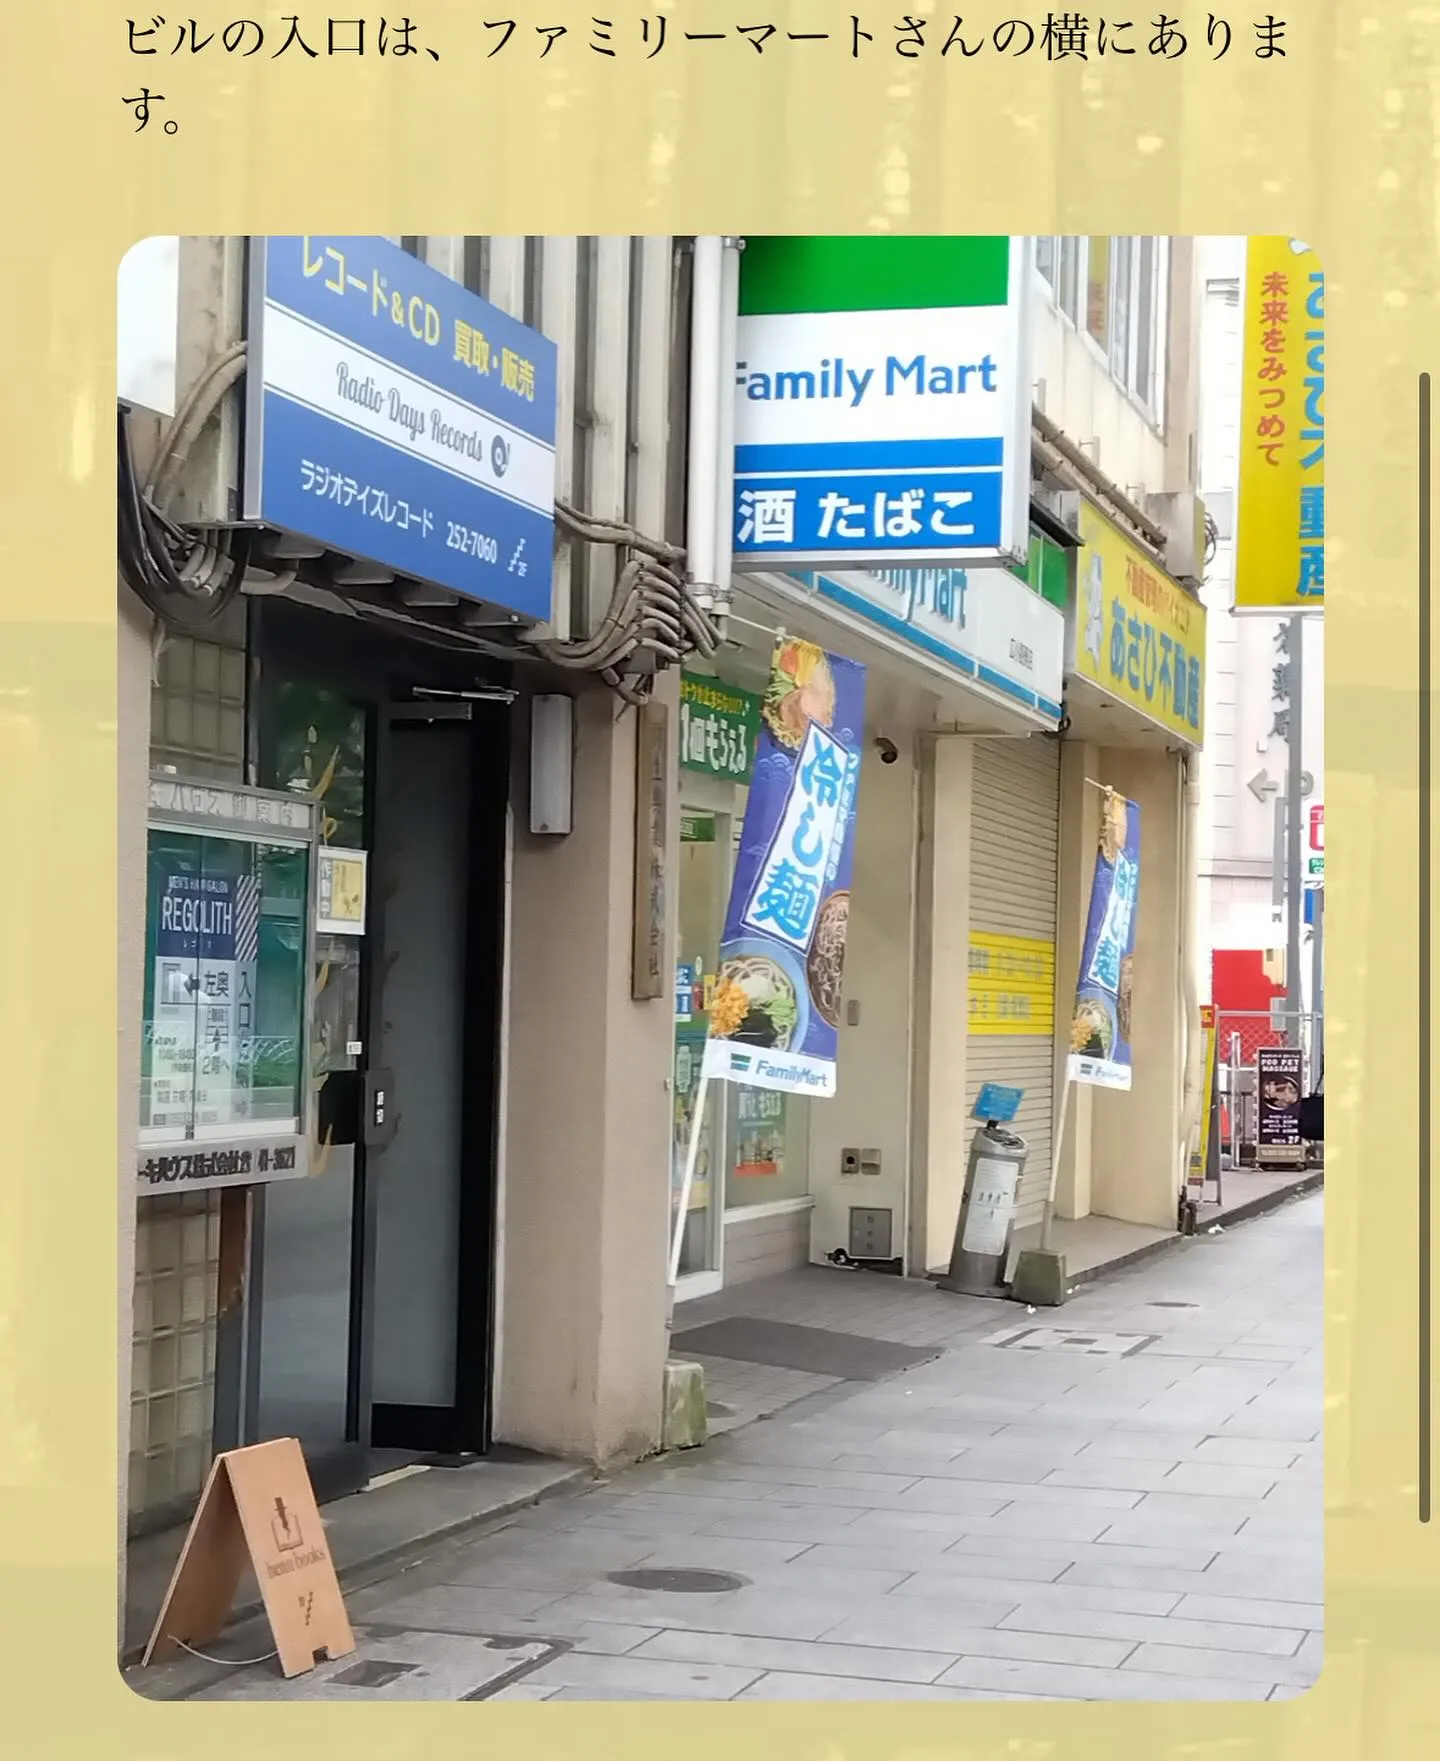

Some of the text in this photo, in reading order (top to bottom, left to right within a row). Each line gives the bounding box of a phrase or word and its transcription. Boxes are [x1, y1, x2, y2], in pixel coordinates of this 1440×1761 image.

[303, 236, 535, 401] レコード&CD 買取・販売
[1257, 272, 1289, 467] 未来をみつめて
[336, 361, 483, 464] Radio Days Records
[301, 458, 435, 539] ラジオデイズレコード
[446, 521, 498, 565] 252-7060
[737, 489, 974, 544] 酒 たばこ
[1111, 596, 1199, 730] あさひ不動産
[753, 731, 844, 938] 冷し麺
[162, 896, 232, 935] REGOLITH
[203, 970, 230, 999] 左奥
